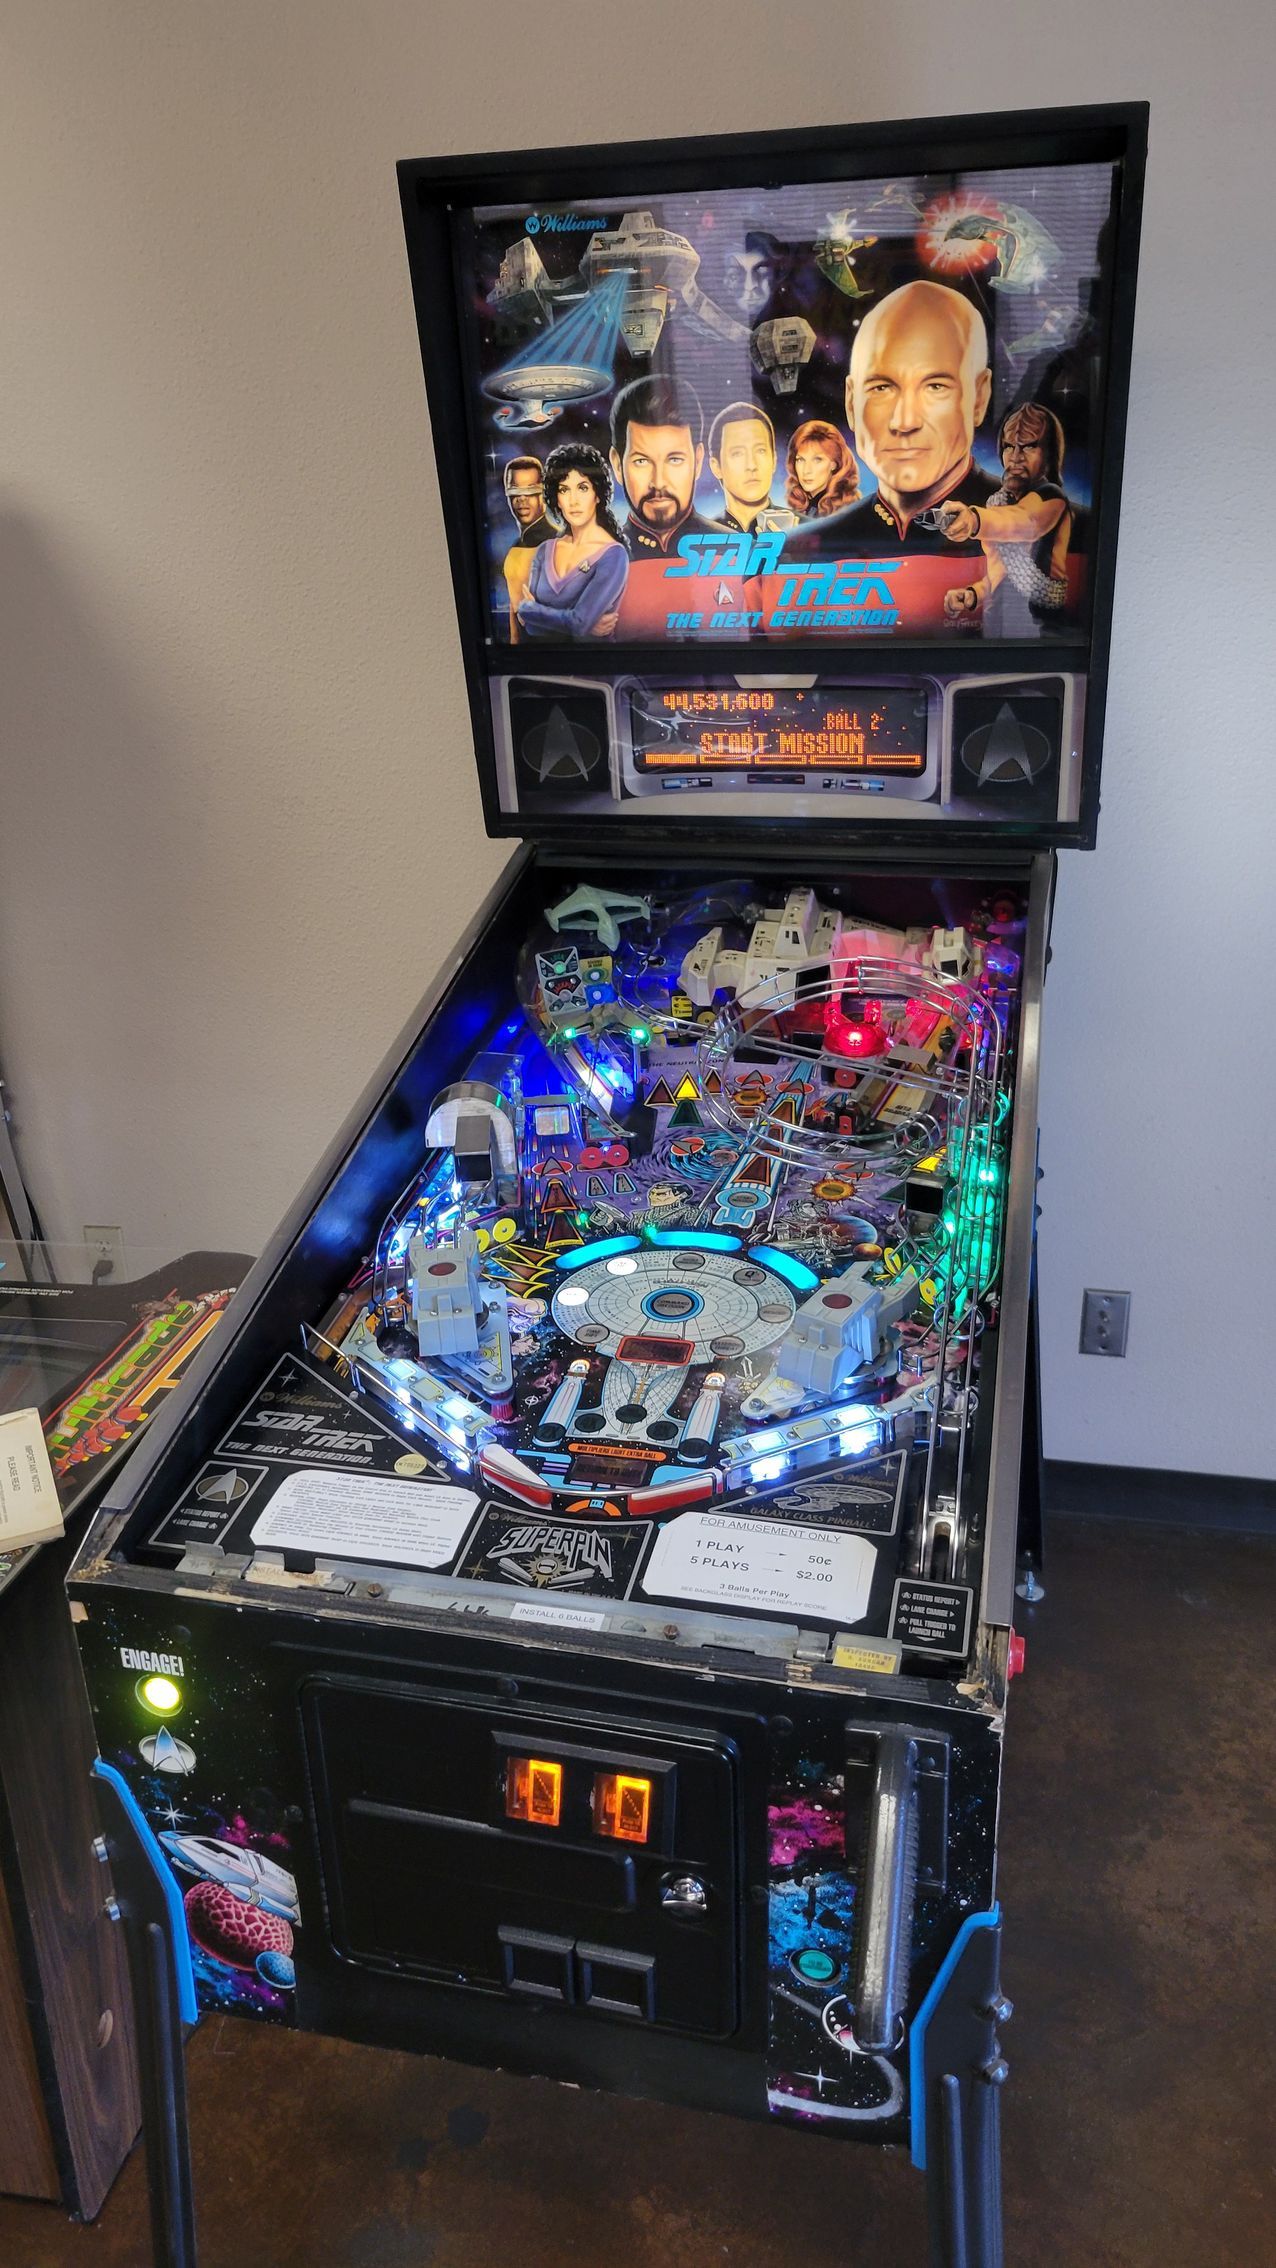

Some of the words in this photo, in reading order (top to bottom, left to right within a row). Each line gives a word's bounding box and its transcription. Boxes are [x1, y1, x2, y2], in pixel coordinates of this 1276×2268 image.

[541, 214, 608, 232] Williams
[664, 532, 785, 577] STAR
[774, 561, 904, 606] TREK
[666, 612, 703, 629] THE
[709, 611, 763, 628] NEXT
[769, 609, 899, 627] GENERATION
[826, 713, 861, 730] BALL
[871, 713, 880, 730] 2
[700, 733, 768, 754] START
[779, 733, 865, 754] MISSION
[48, 1300, 202, 1458] ulticade
[276, 1393, 343, 1409] Williams
[241, 1410, 325, 1432] STAR
[303, 1429, 386, 1452] TREK
[25, 1445, 38, 1475] IMPORTANT
[225, 1442, 252, 1450] THE
[252, 1444, 289, 1454] NEXT
[290, 1450, 373, 1465] GENERATION
[7, 1456, 19, 1477] PLEASE
[30, 1474, 42, 1494] NOTICE
[750, 1507, 793, 1519] GALAXY
[793, 1512, 824, 1523] CLASS
[827, 1516, 872, 1528] PINBALL
[700, 1517, 725, 1527] FOR
[728, 1521, 805, 1538] AMUSEMENT
[808, 1532, 841, 1543] ONLY
[486, 1526, 612, 1578] SUPERPIN
[707, 1541, 744, 1553] PLAY
[808, 1556, 832, 1566] 50¢
[690, 1556, 698, 1564] 5
[702, 1557, 749, 1571] PLAYS
[796, 1570, 833, 1582] $2.00
[731, 1584, 750, 1593] Balls
[770, 1590, 790, 1599] Play
[520, 1608, 556, 1619] INSTALL
[566, 1615, 596, 1623] BALLS
[120, 1647, 185, 1677] ENGAGE!
